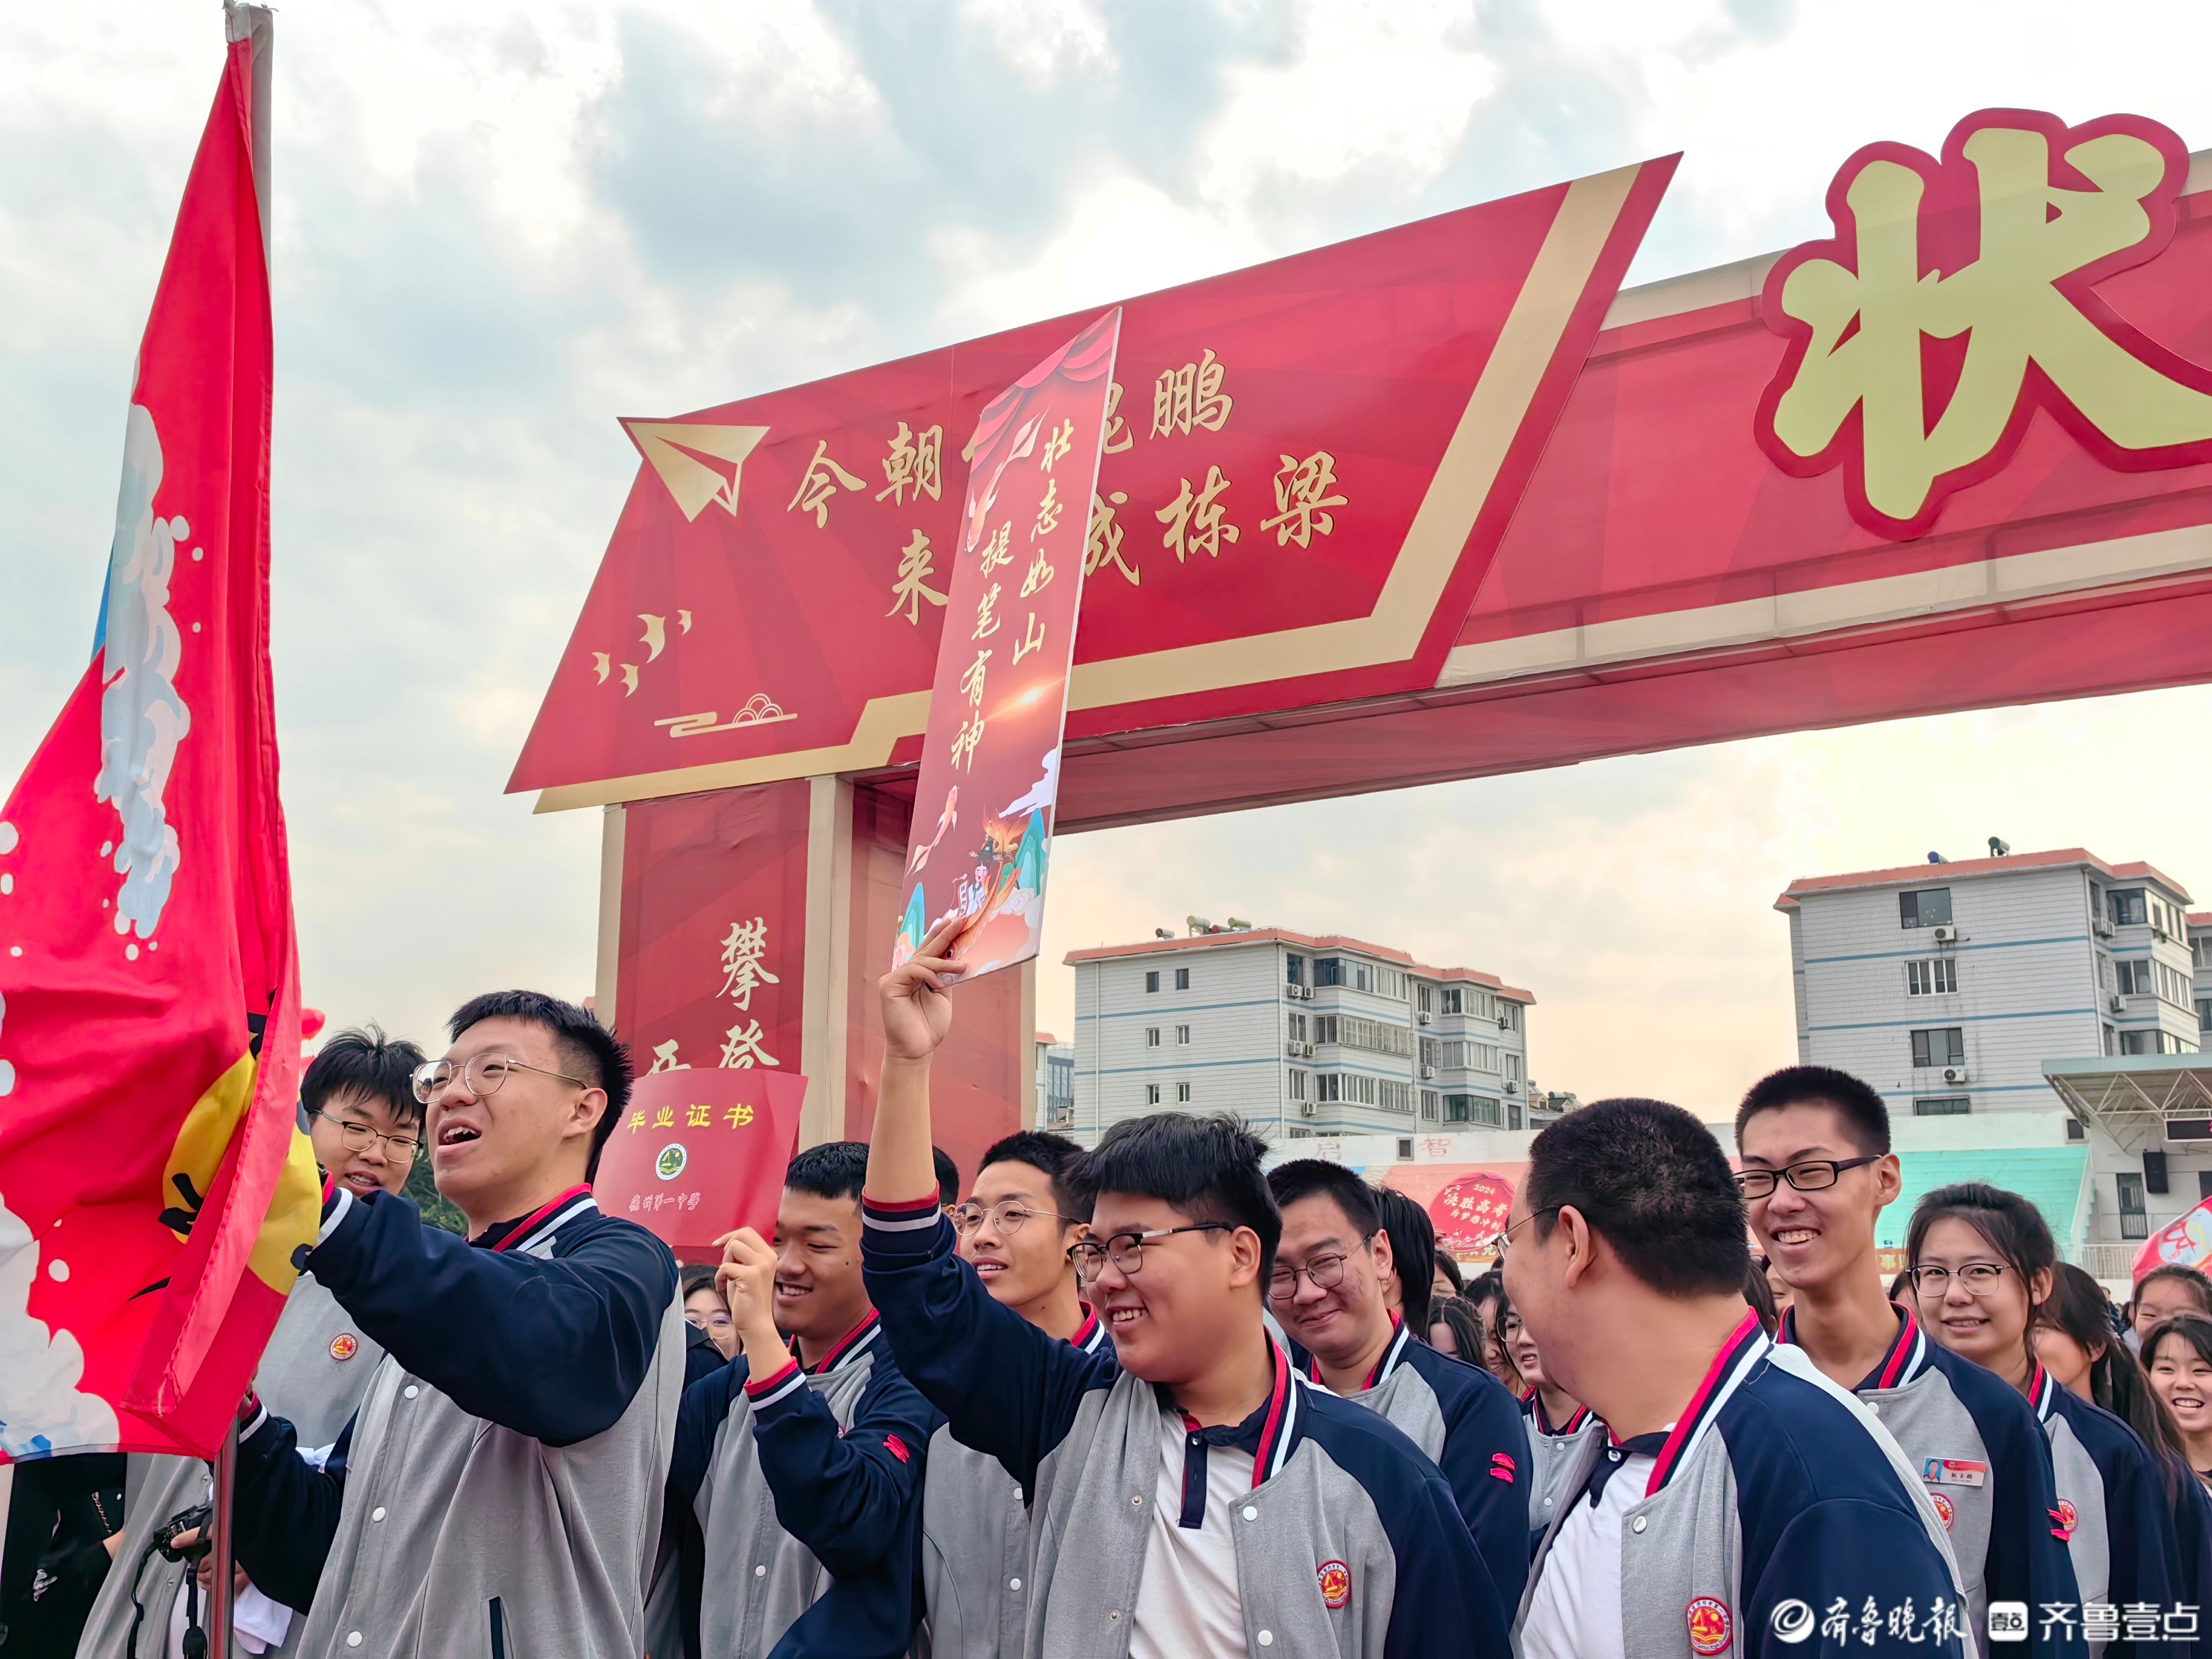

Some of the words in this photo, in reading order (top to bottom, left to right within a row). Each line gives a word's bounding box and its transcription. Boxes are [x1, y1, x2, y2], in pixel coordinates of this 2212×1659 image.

[1773, 127, 2212, 520] 状
[787, 348, 1233, 529] 今朝鹏
[885, 450, 1349, 626] 来成栋梁
[1012, 418, 1074, 665] 壮志如山
[951, 520, 1014, 775] 提笔有神
[626, 1103, 754, 1134] 毕业证书
[1444, 1192, 1508, 1218] 决胜高考
[1473, 1184, 1496, 1195] 2024
[1450, 1209, 1502, 1231] 为梦想冲刺
